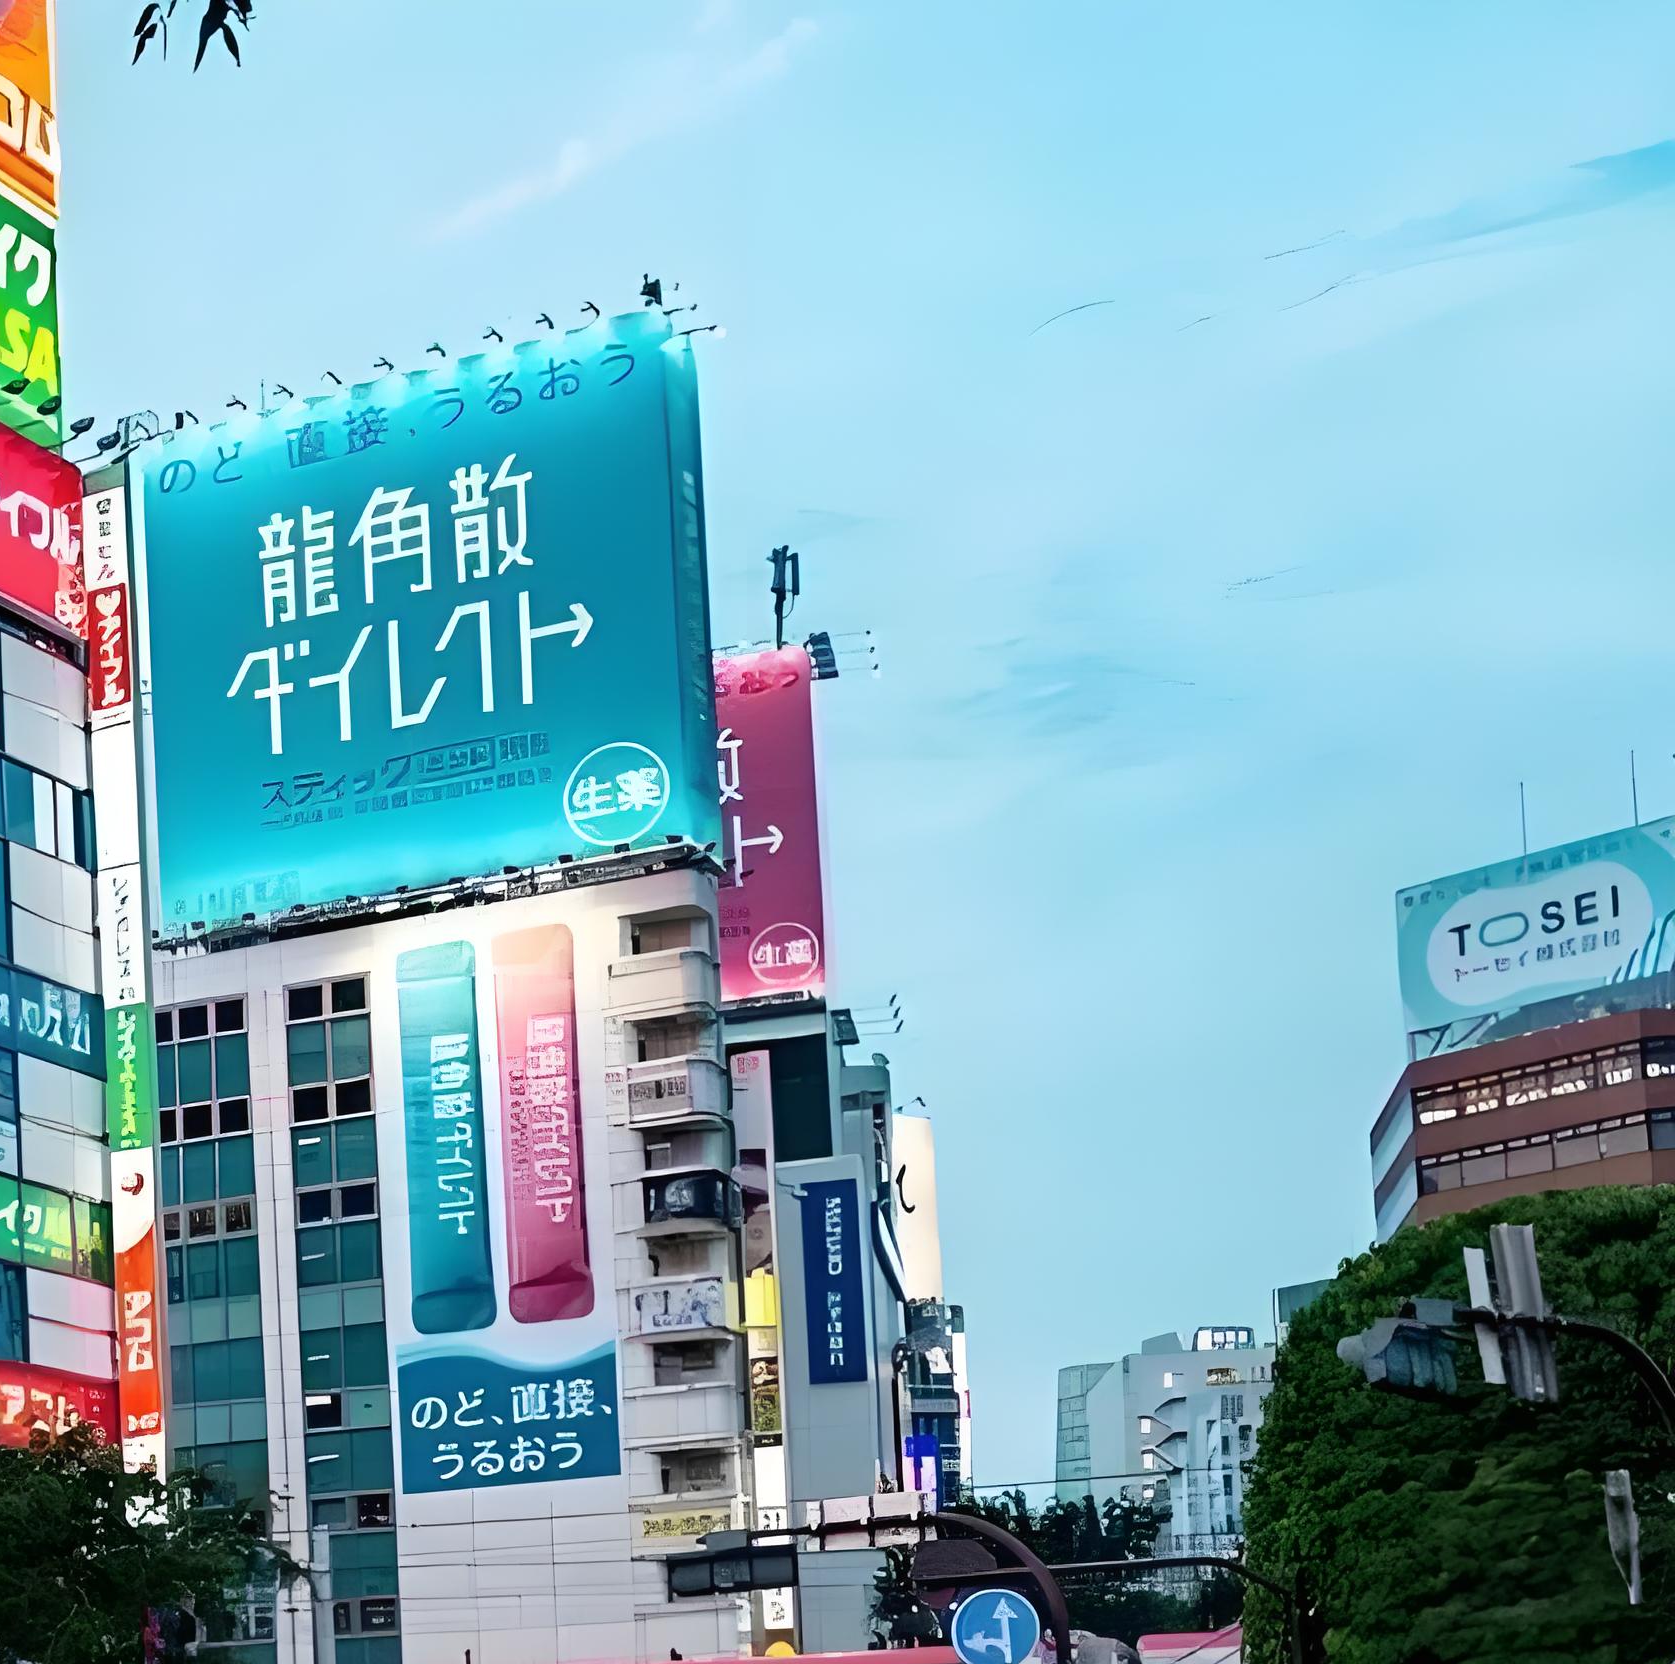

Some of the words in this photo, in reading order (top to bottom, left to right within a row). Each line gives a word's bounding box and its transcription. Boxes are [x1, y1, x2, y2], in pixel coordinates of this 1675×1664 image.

[257, 452, 535, 628] 龍角散
[226, 590, 594, 755] ダイレクト
[1447, 885, 1620, 957] TOSEI
[432, 1431, 584, 1479] うるおう
